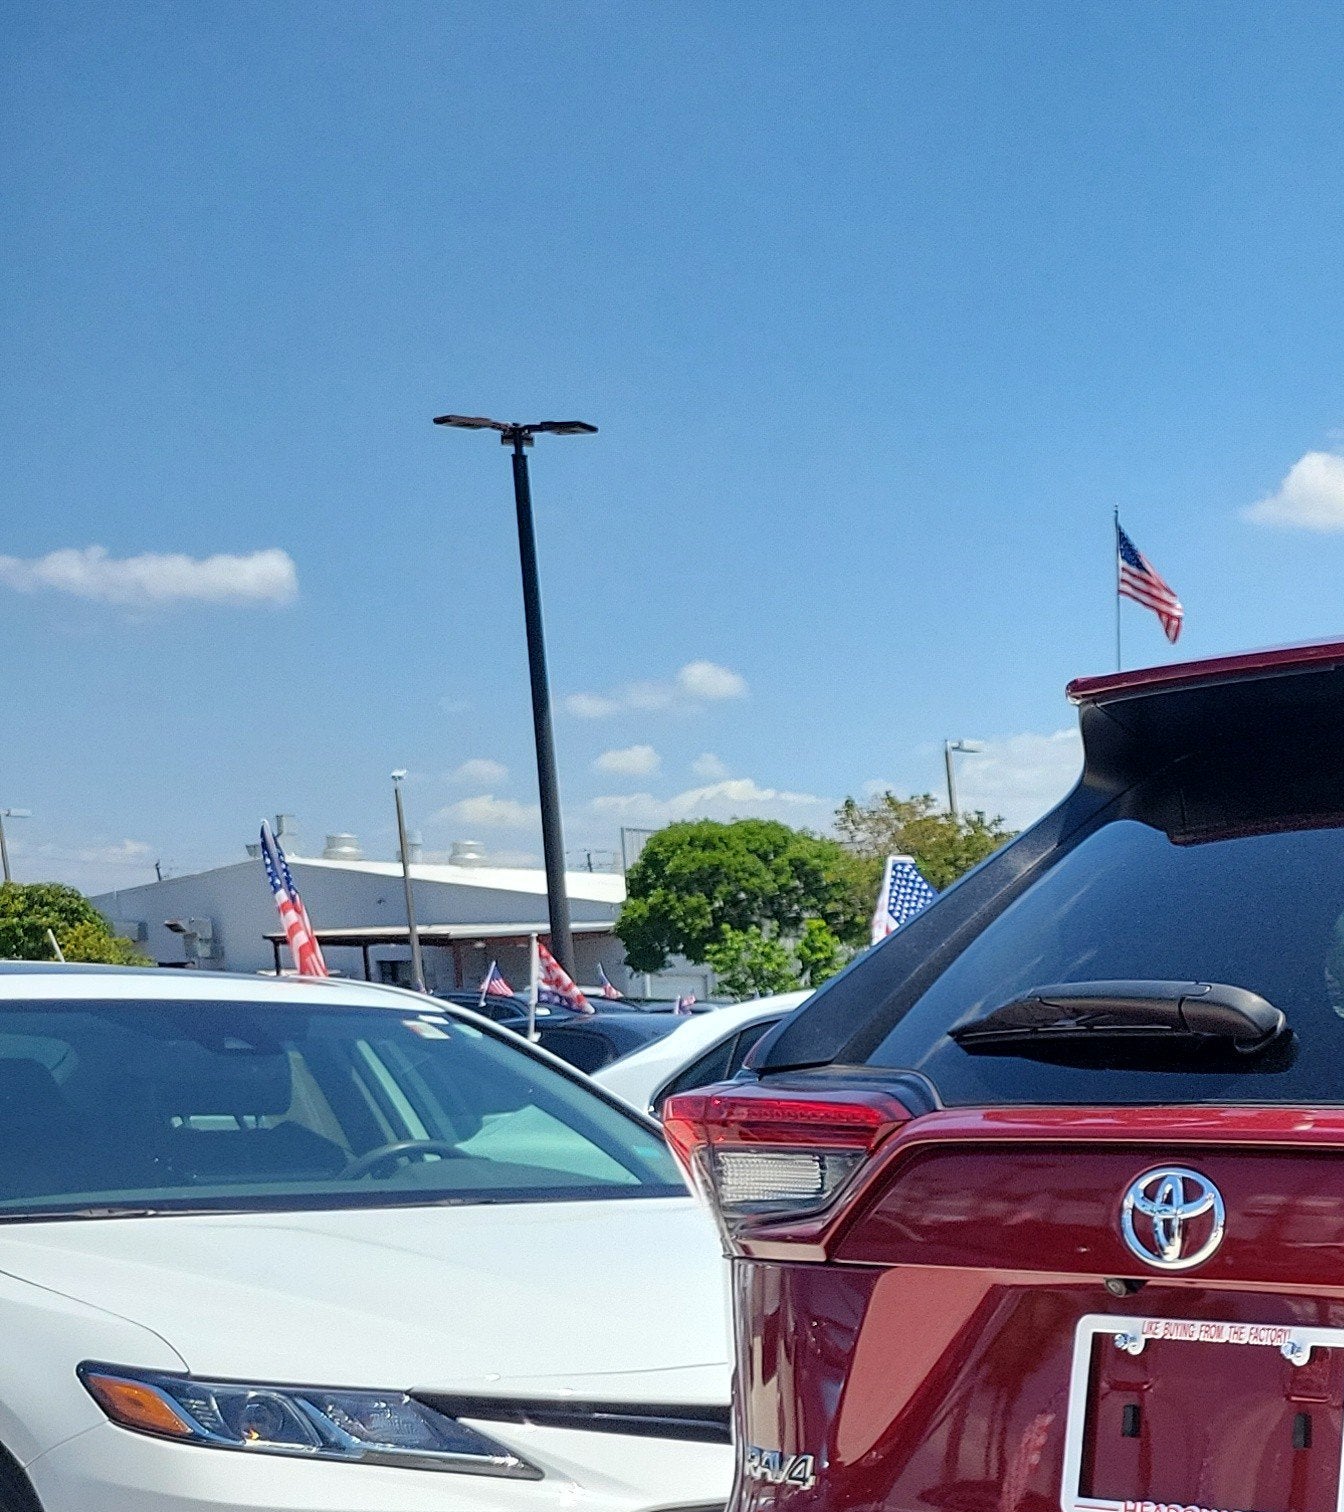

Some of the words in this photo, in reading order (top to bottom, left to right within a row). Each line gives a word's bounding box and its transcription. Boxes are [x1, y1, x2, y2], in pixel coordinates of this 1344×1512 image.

[1142, 1321, 1159, 1336] LIKE
[1163, 1322, 1196, 1338] BUYING
[1200, 1324, 1225, 1339] FROM
[1229, 1325, 1245, 1341] THE
[745, 1446, 816, 1491] RAV4
